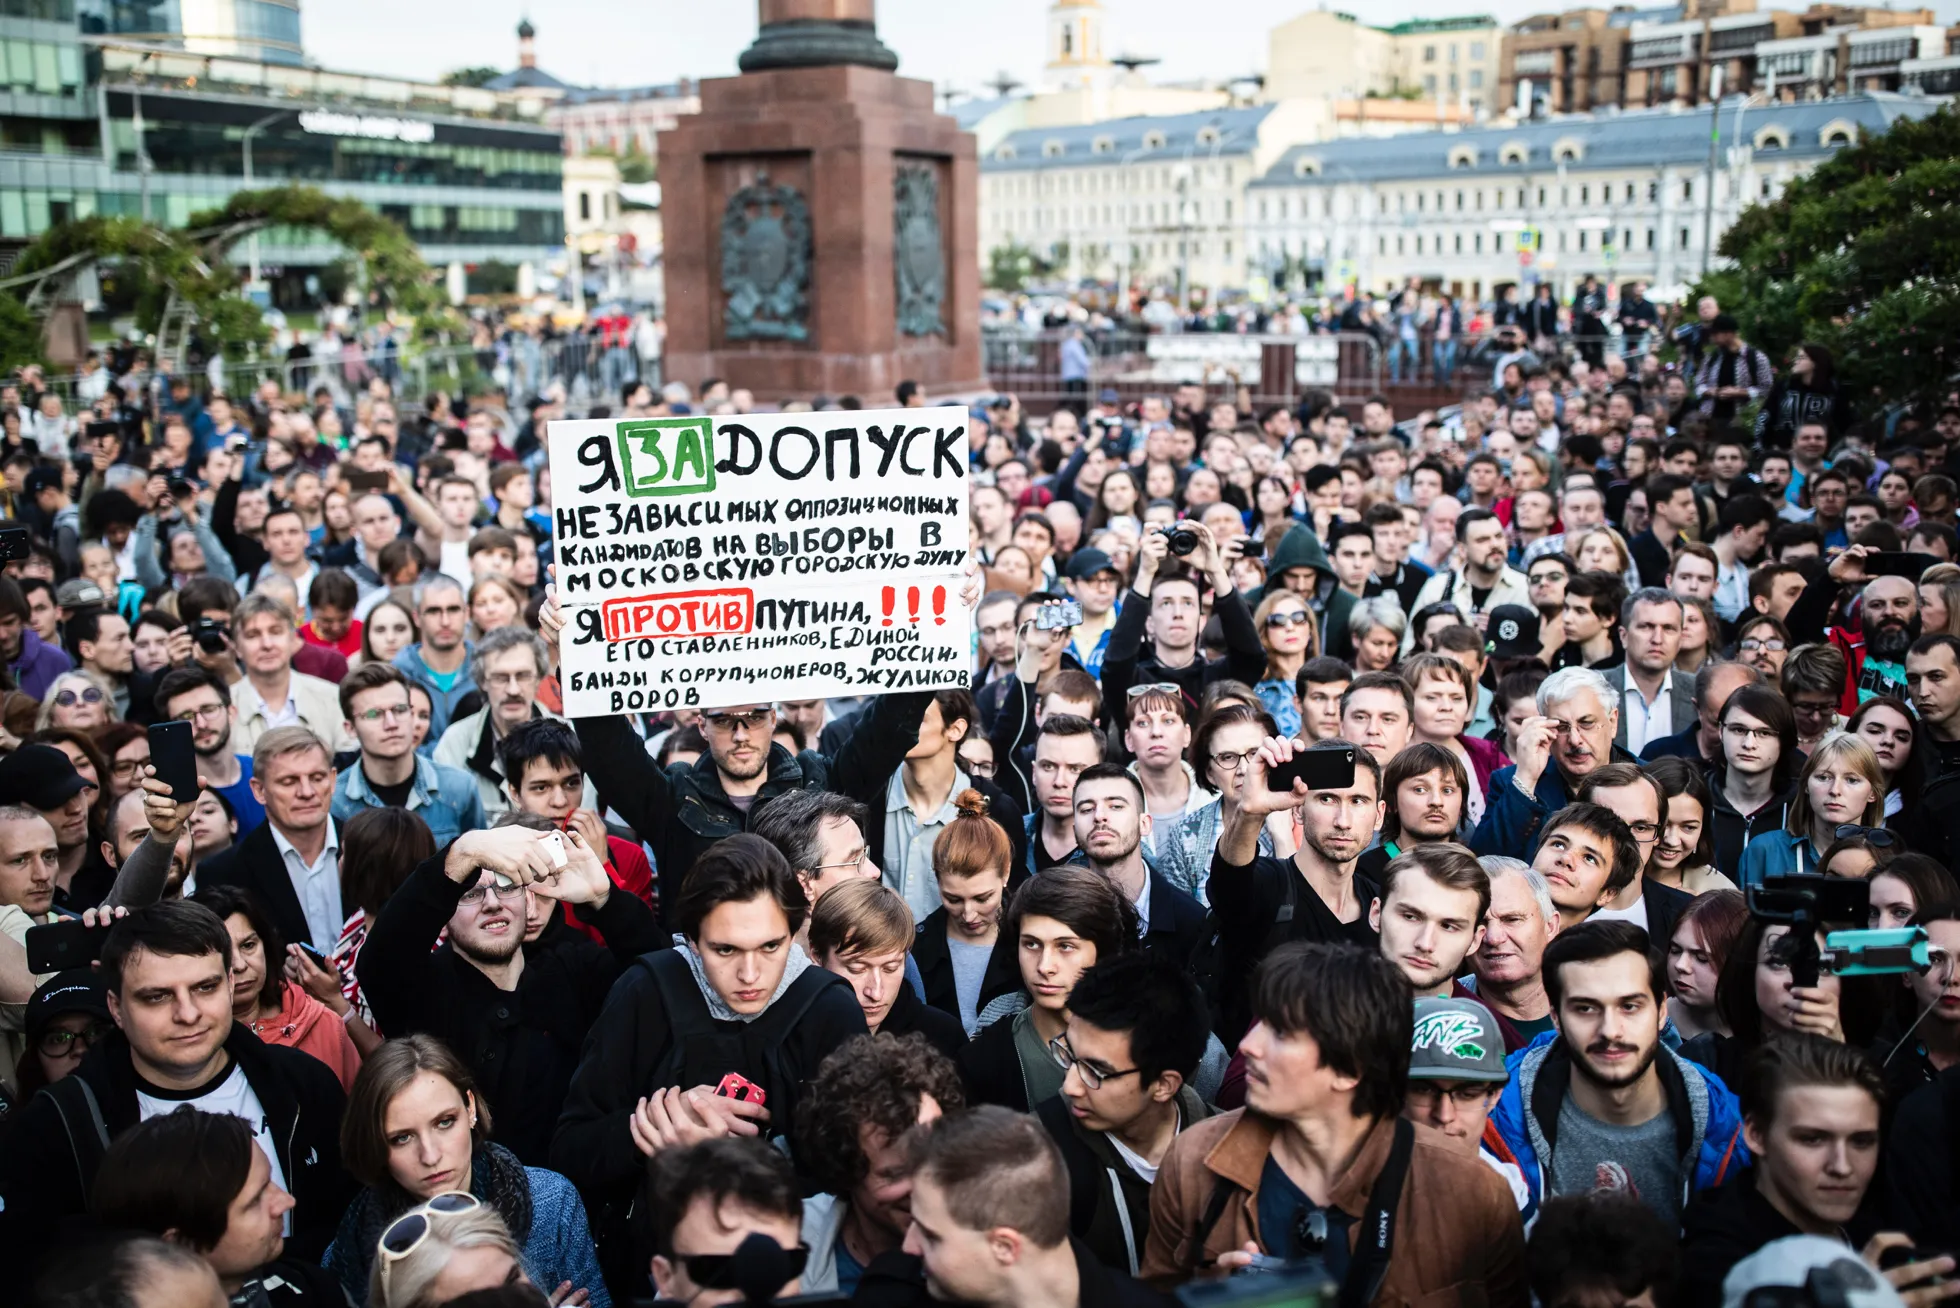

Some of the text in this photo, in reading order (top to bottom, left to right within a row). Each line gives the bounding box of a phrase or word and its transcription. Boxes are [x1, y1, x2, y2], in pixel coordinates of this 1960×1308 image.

[577, 423, 965, 494] Я ЗА ДОПУСК
[556, 495, 959, 541] НЕЗАВИСИМЫХ ОППОЗИЦИОННЫХ
[560, 521, 942, 567] КАНДИДАТОВ НА ВЫБОРЫ В
[566, 549, 967, 593] МОСКОВСКУЮ ГОРОДСКУЮ ДУМУ
[572, 608, 606, 646] Я
[610, 600, 745, 640] ПРОТИВ
[755, 598, 872, 632] ПУТИНА,
[606, 623, 920, 663] ЕГО СТАВЛЕННИКОВ, ЕДИНОЙ
[870, 644, 958, 666] РОССИИ,
[570, 670, 648, 692] БАНДЫ
[660, 661, 853, 685] КОРРУПЦИОНЕРОВ,
[610, 686, 701, 713] ВОРОВ
[42, 985, 91, 1002] Champion
[1378, 1209, 1390, 1249] SONY
